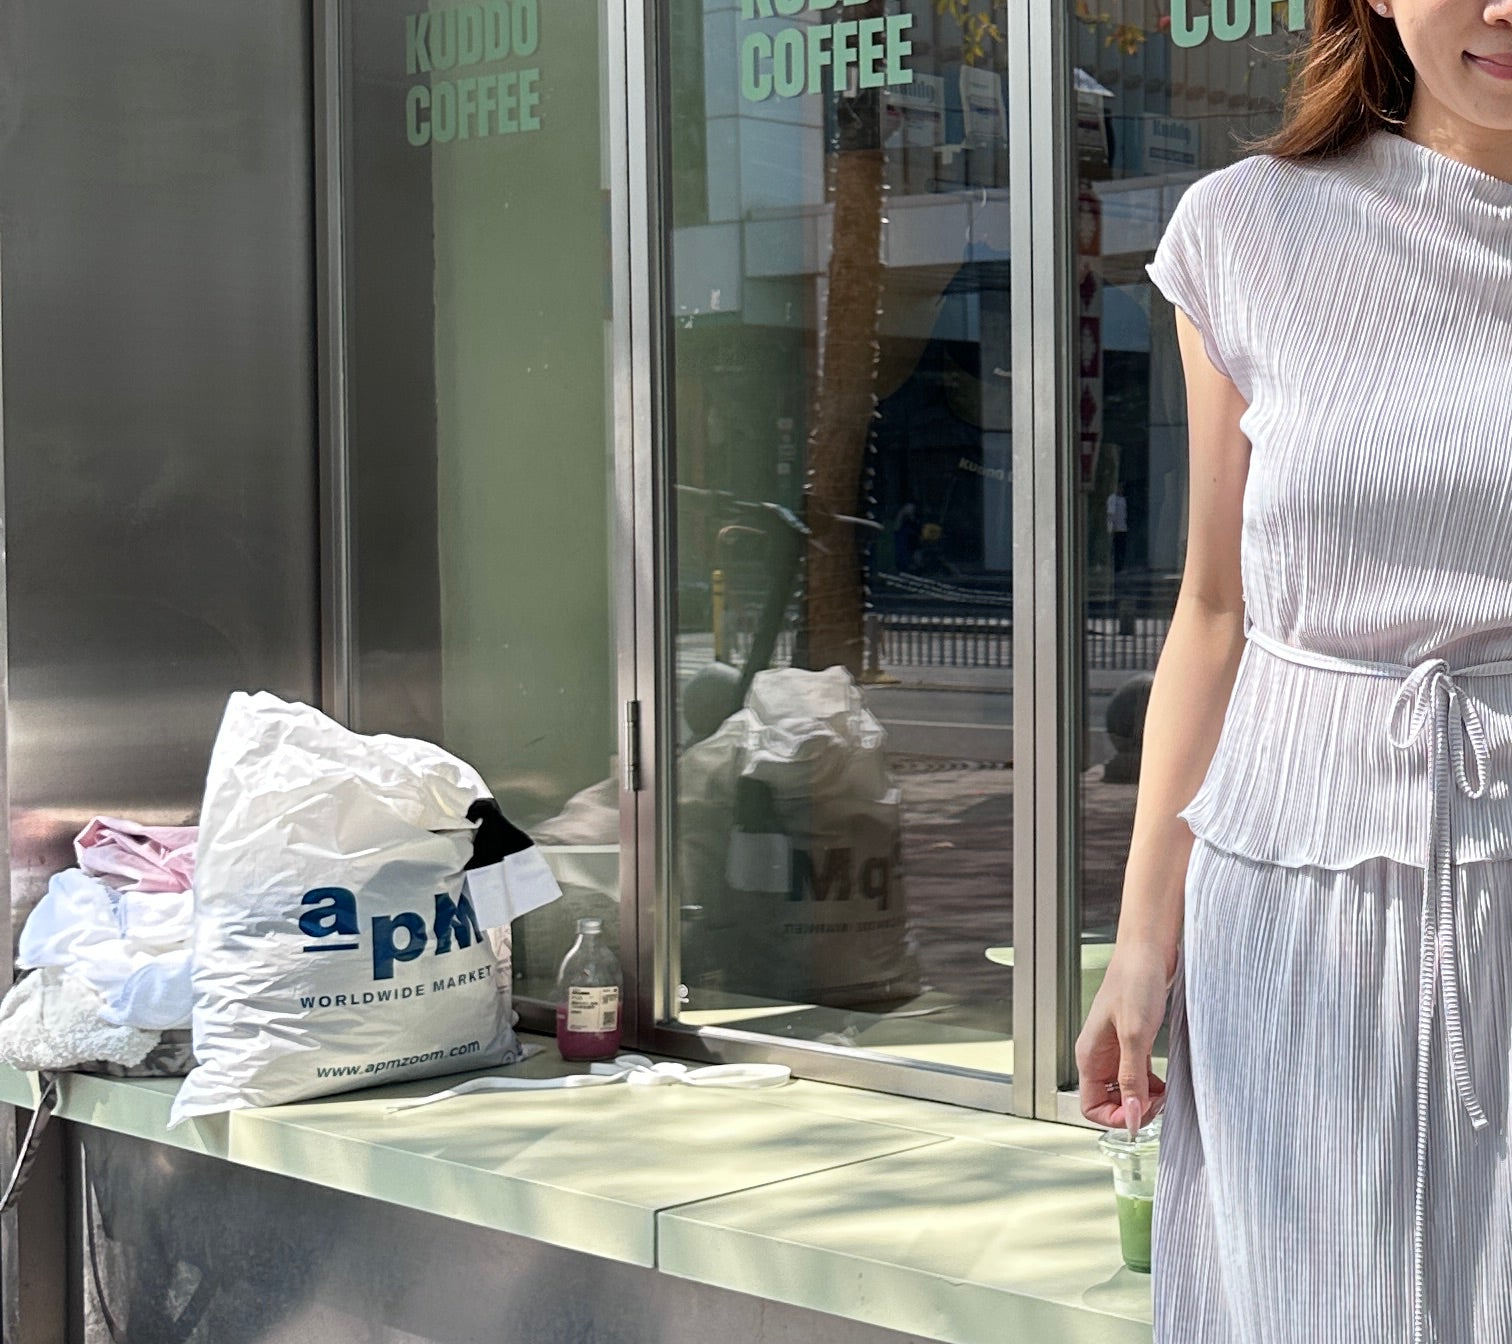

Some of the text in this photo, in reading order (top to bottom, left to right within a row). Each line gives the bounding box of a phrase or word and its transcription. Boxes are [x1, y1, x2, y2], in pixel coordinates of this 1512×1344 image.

[741, 13, 913, 102] COFFEE
[406, 68, 541, 147] COFFEE
[301, 964, 493, 1009] WORLDWIDE MARKET
[316, 1040, 481, 1078] www.apmzoom.com
